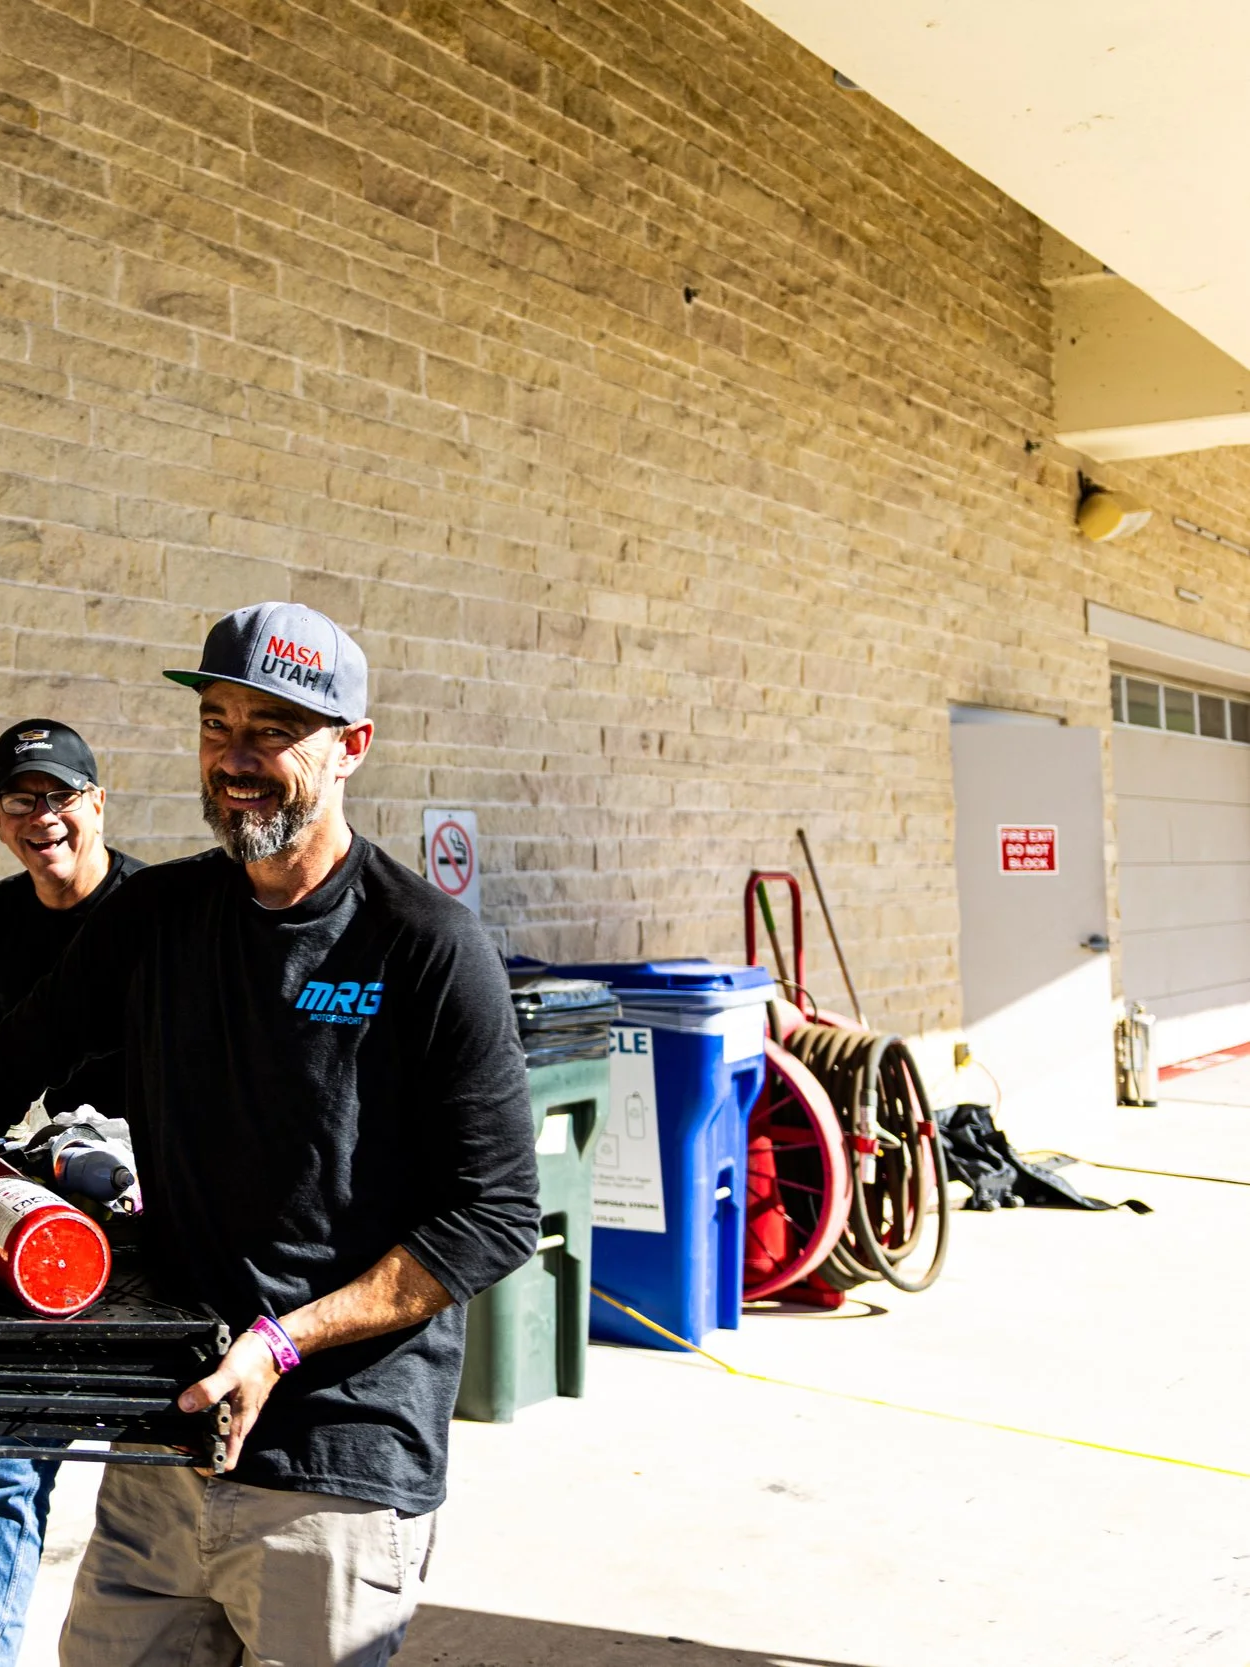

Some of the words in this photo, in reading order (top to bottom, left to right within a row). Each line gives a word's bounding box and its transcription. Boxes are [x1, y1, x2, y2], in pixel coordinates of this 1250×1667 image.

[266, 635, 323, 671] NASA
[260, 654, 321, 691] UTAH
[1002, 830, 1027, 842] FIRE
[1006, 843, 1024, 856] DO
[1025, 843, 1049, 856] NOT
[1008, 857, 1049, 869] BLOCK
[295, 981, 384, 1015] MRG
[310, 1013, 363, 1025] MOTORSPORT
